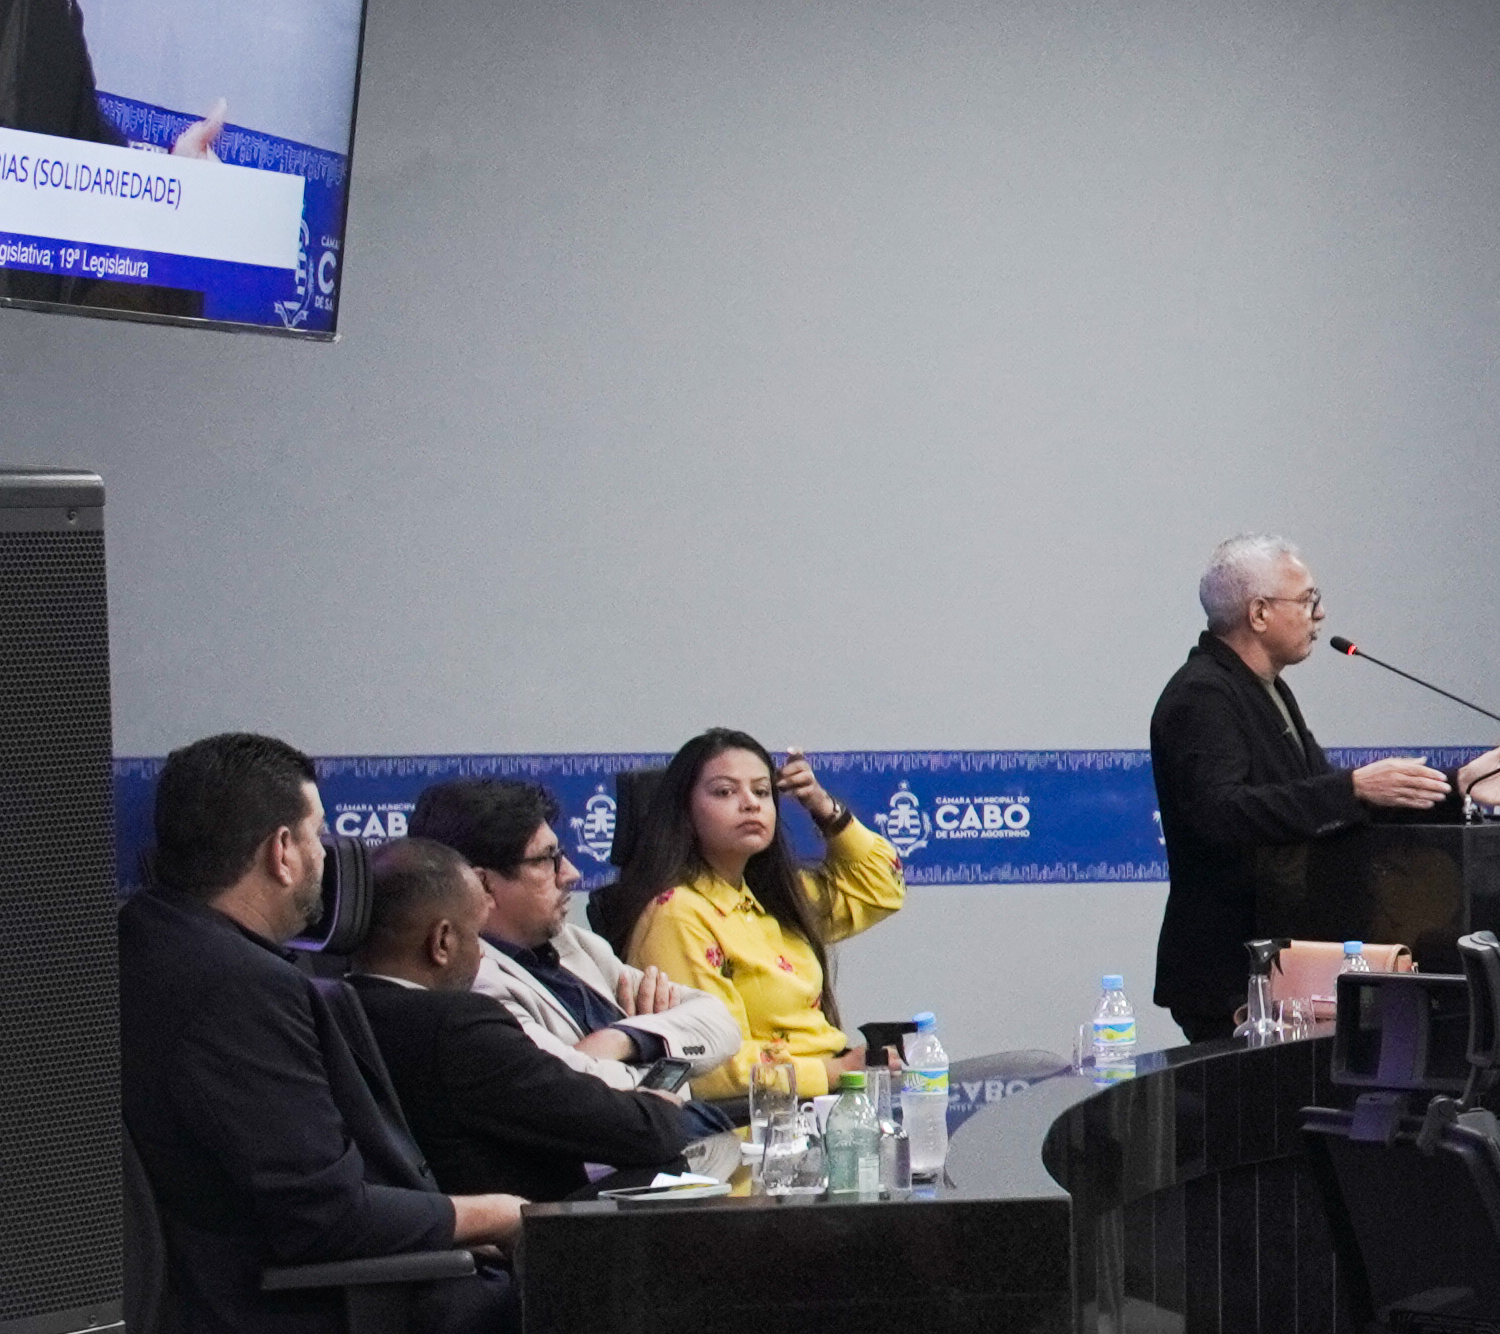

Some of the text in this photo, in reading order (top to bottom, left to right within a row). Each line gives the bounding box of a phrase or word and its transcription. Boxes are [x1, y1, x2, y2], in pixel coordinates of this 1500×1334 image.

[0, 153, 182, 210] IAS (SOLIDARIEDADE)
[82, 250, 149, 278] Legislatura
[335, 812, 409, 838] CAB
[935, 804, 1031, 830] CABO
[935, 829, 1031, 839] DE SANTO AGOSTINHO
